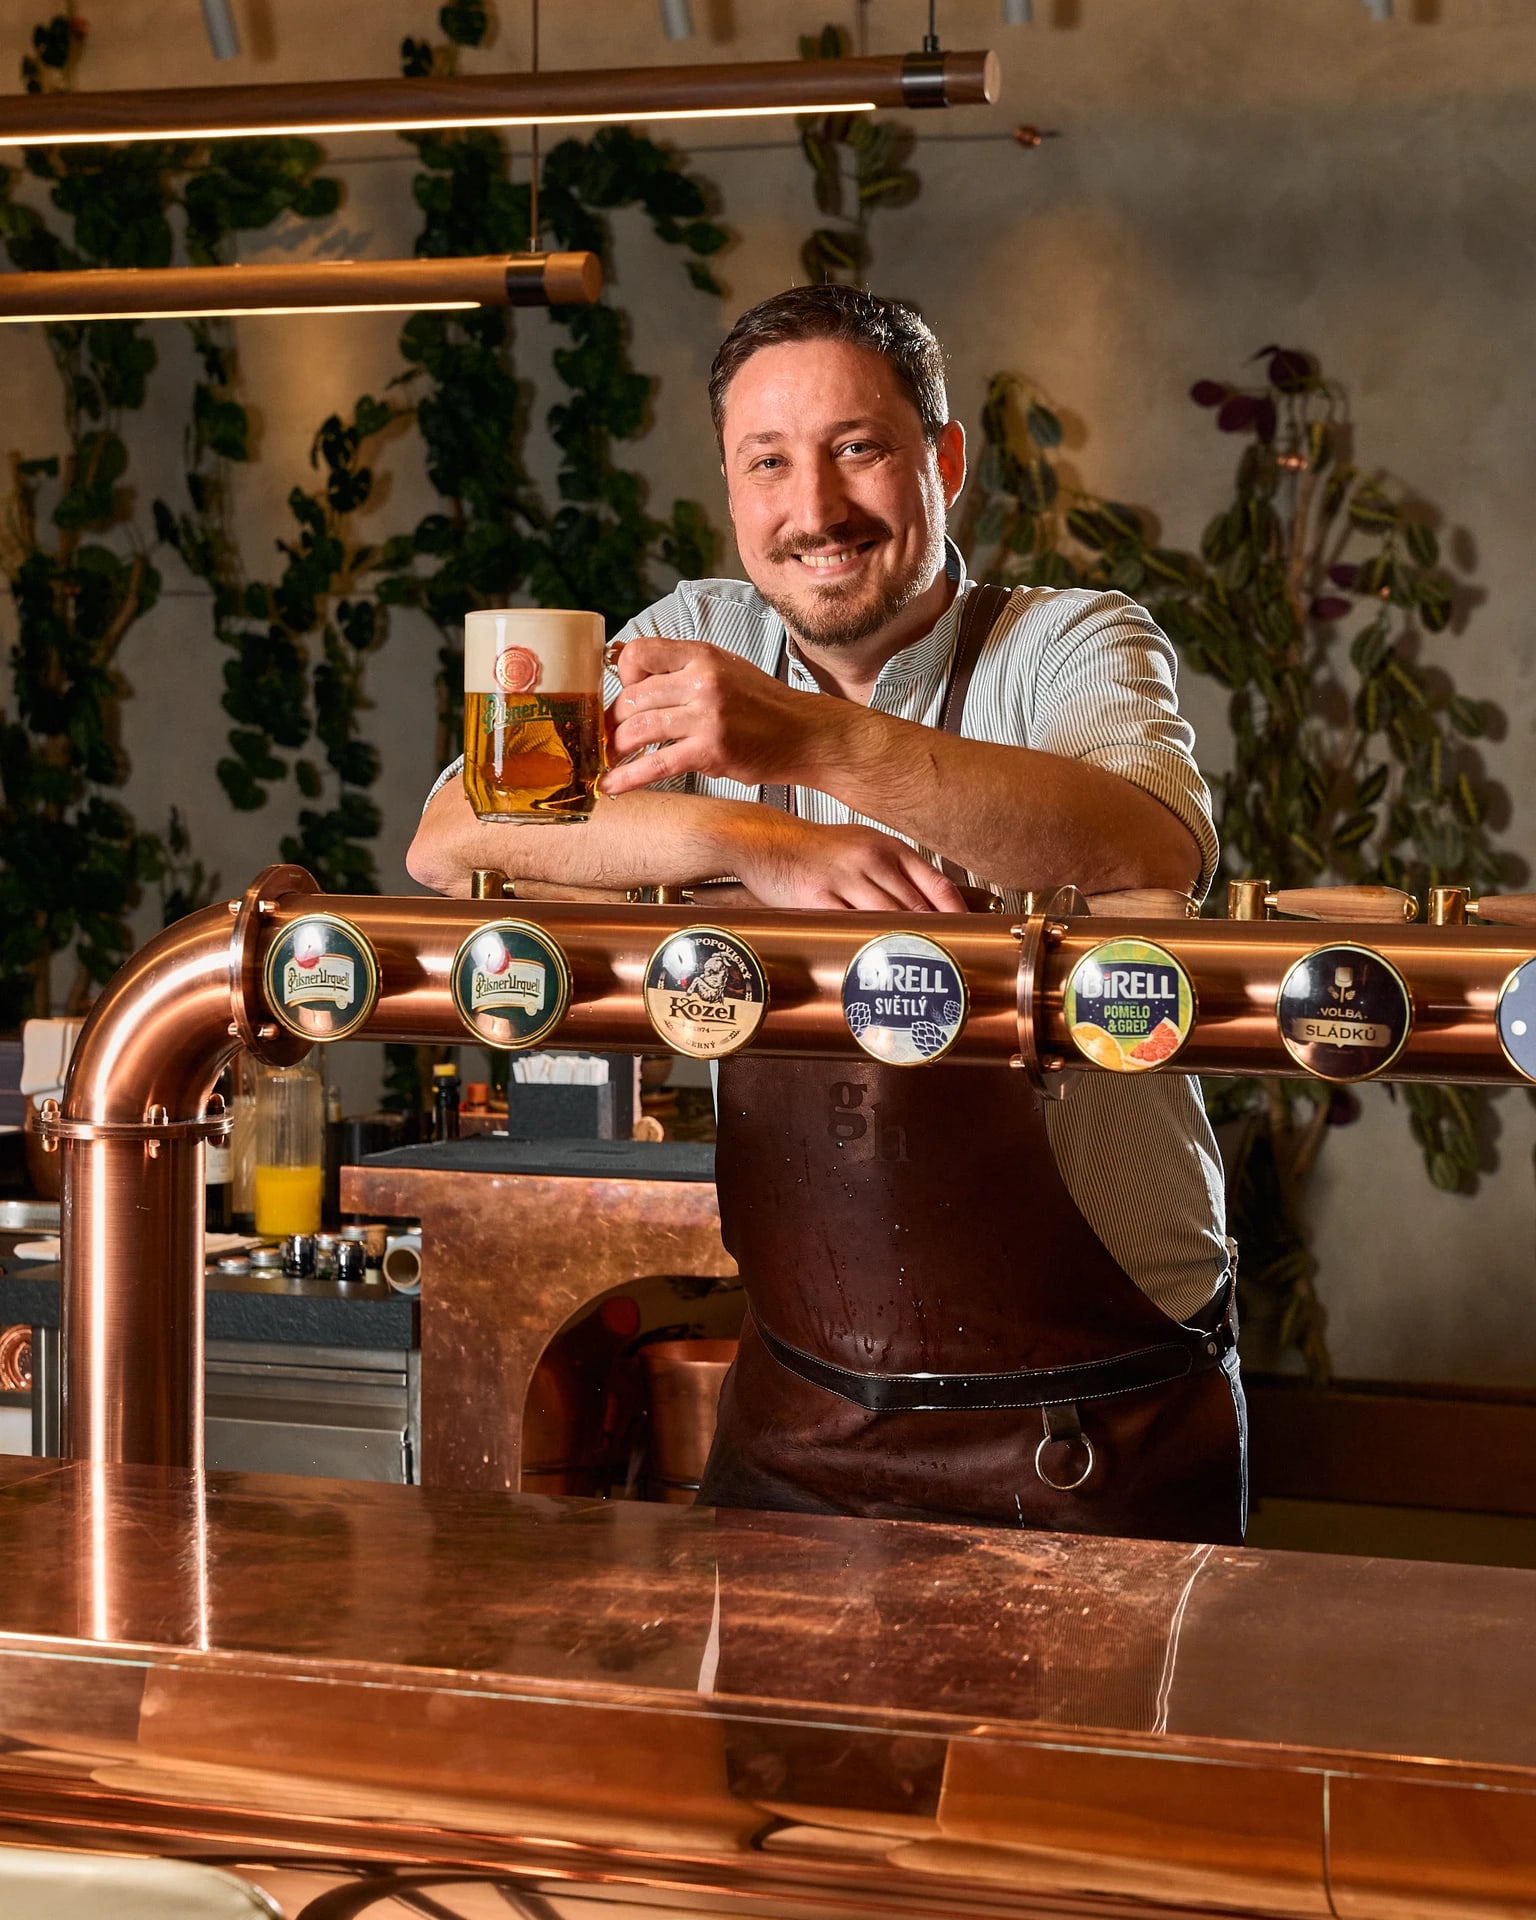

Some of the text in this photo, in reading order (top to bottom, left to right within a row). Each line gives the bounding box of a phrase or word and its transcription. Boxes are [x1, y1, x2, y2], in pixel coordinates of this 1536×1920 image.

[287, 967, 350, 994] Pilsner Urquell
[475, 972, 540, 999] Pilsner Urquell
[669, 996, 737, 1023] Kozel
[875, 995, 927, 1016] SVĚTLÝ
[1104, 1005, 1151, 1019] POMELO
[1320, 1007, 1363, 1020] VOLBA
[1305, 1024, 1377, 1041] SLÁDKŮ
